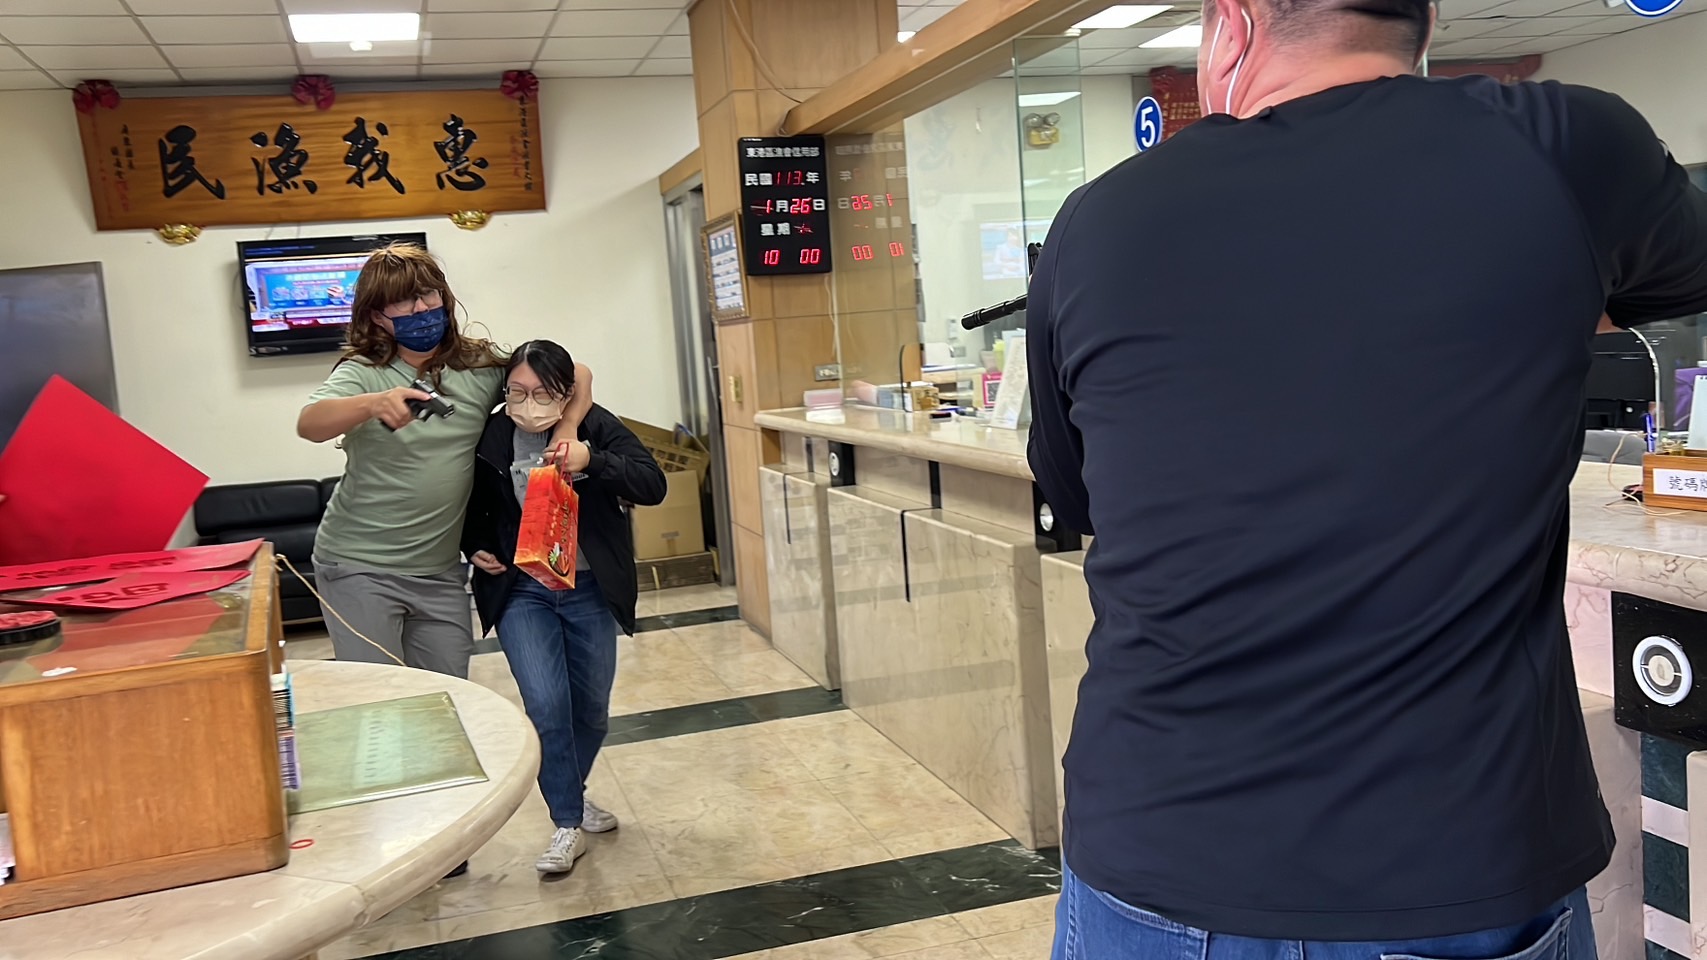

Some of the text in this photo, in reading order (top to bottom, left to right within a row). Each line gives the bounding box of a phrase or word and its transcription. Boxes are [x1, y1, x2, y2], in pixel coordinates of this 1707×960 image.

[1140, 106, 1156, 148] 5
[764, 248, 820, 266] 10 00
